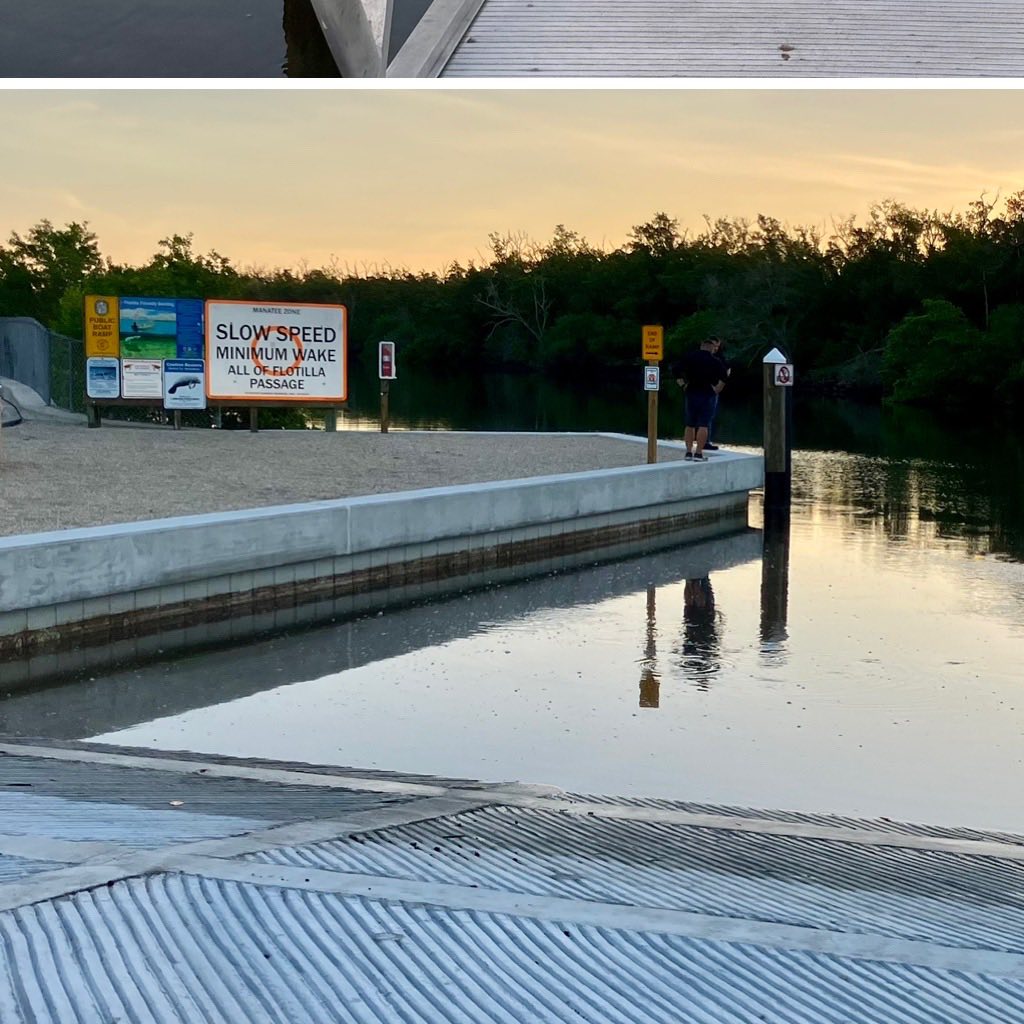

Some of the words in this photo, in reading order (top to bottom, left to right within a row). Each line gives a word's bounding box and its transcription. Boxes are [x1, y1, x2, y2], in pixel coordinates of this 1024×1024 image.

[252, 307, 281, 315] MANATEE
[216, 323, 271, 341] SLOW
[276, 325, 337, 343] SPEED
[216, 346, 288, 361] MINIMUM
[292, 348, 337, 362] WAKE
[228, 365, 250, 376] ALL
[253, 365, 270, 376] OF
[272, 366, 326, 377] FLOTILLA
[250, 378, 305, 389] PASSAGE
